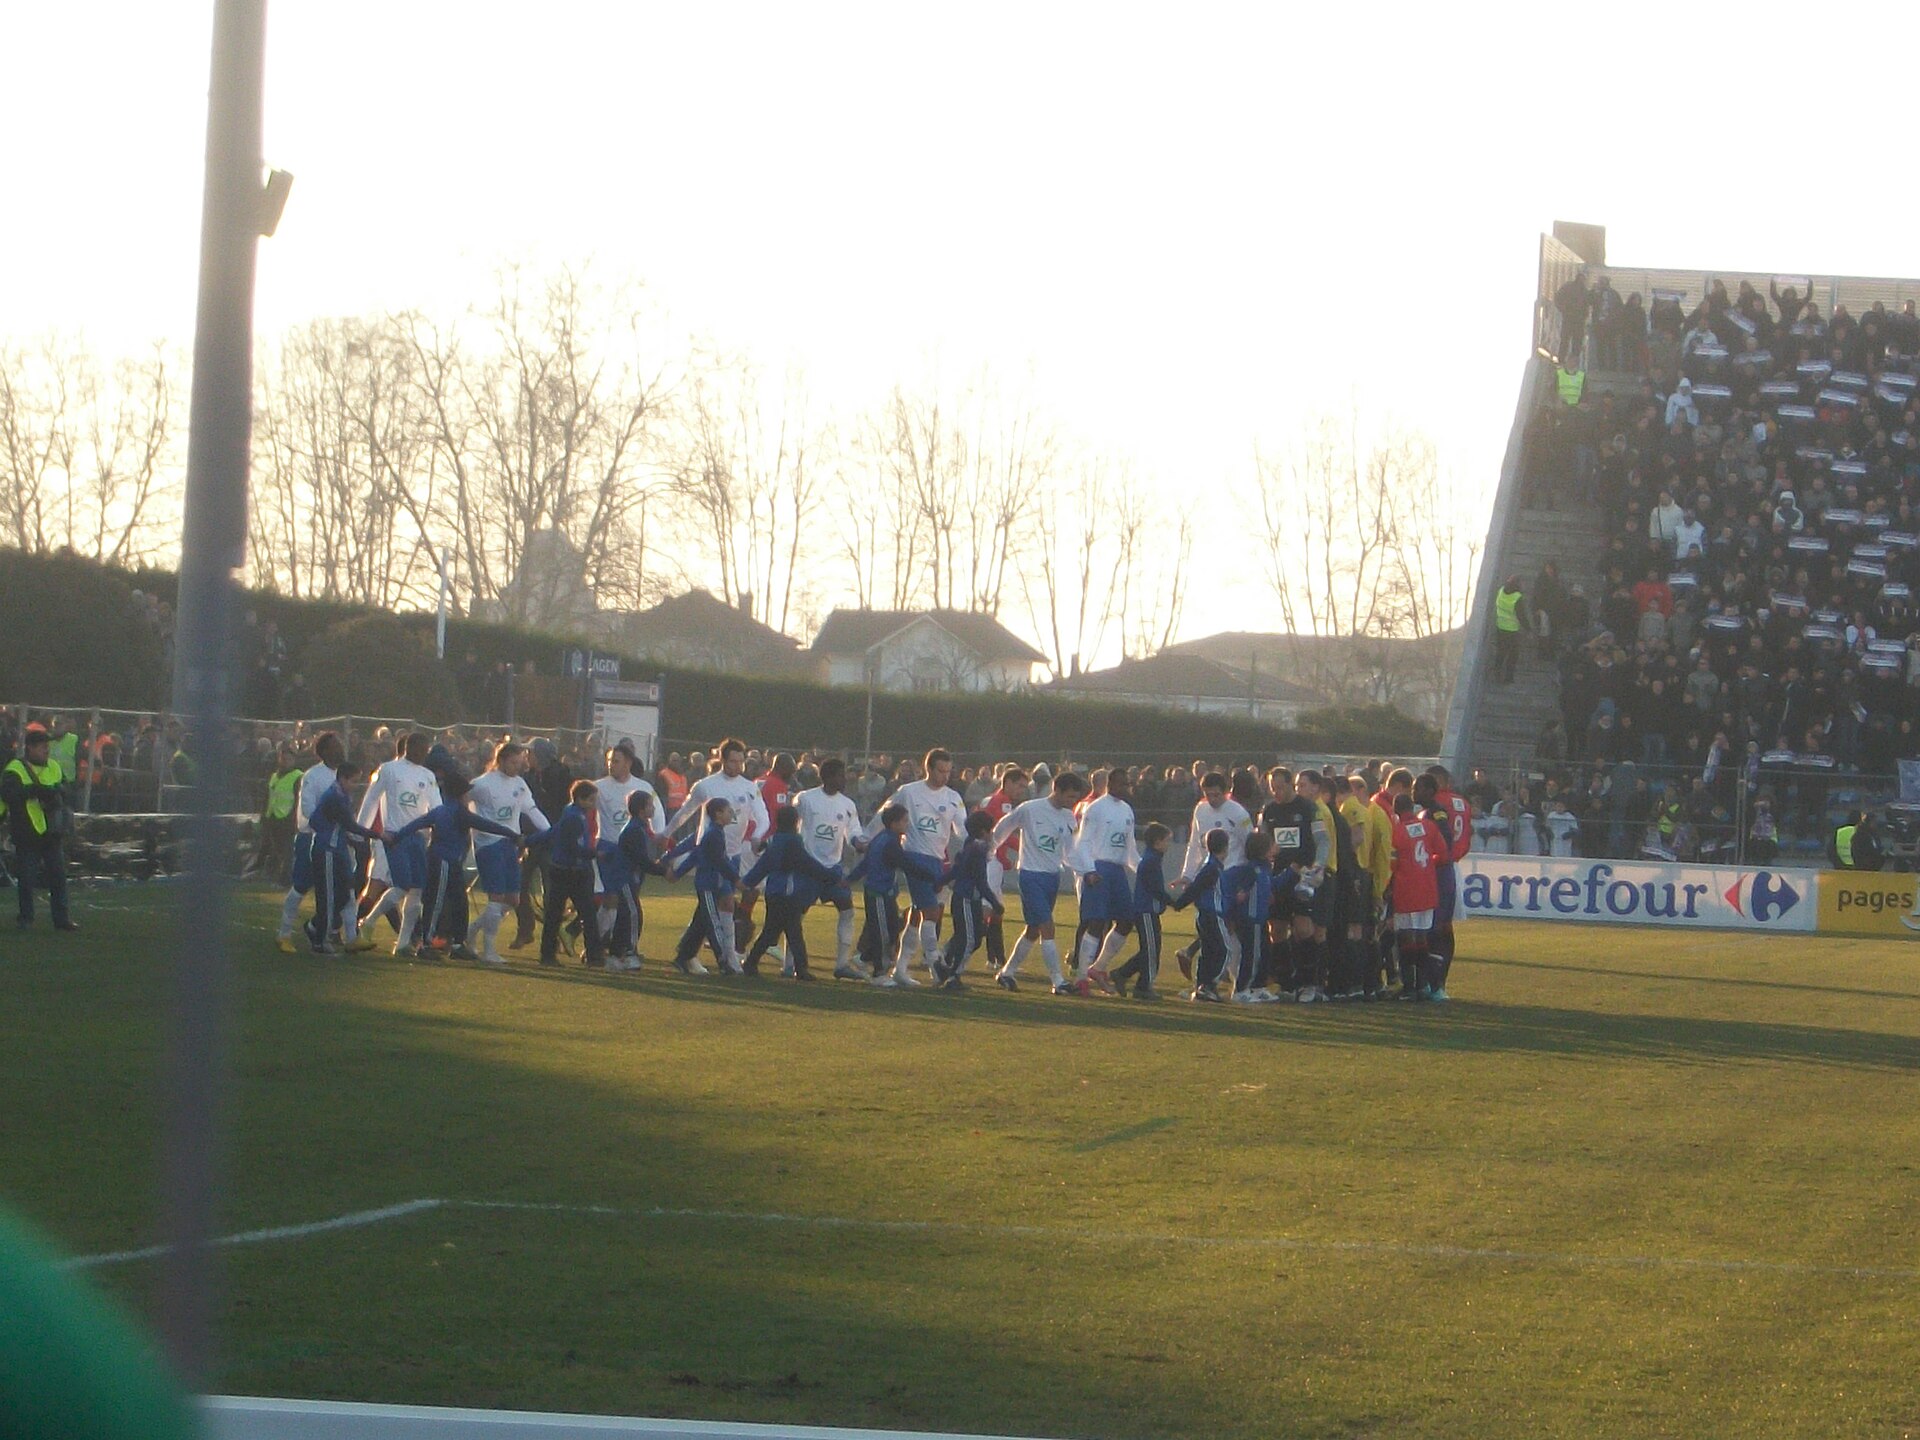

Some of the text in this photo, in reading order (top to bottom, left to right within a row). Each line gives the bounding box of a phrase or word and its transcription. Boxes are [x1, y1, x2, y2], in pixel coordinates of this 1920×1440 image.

[1414, 840, 1430, 868] 4
[1462, 863, 1708, 919] arrefour
[1837, 889, 1914, 913] pages
